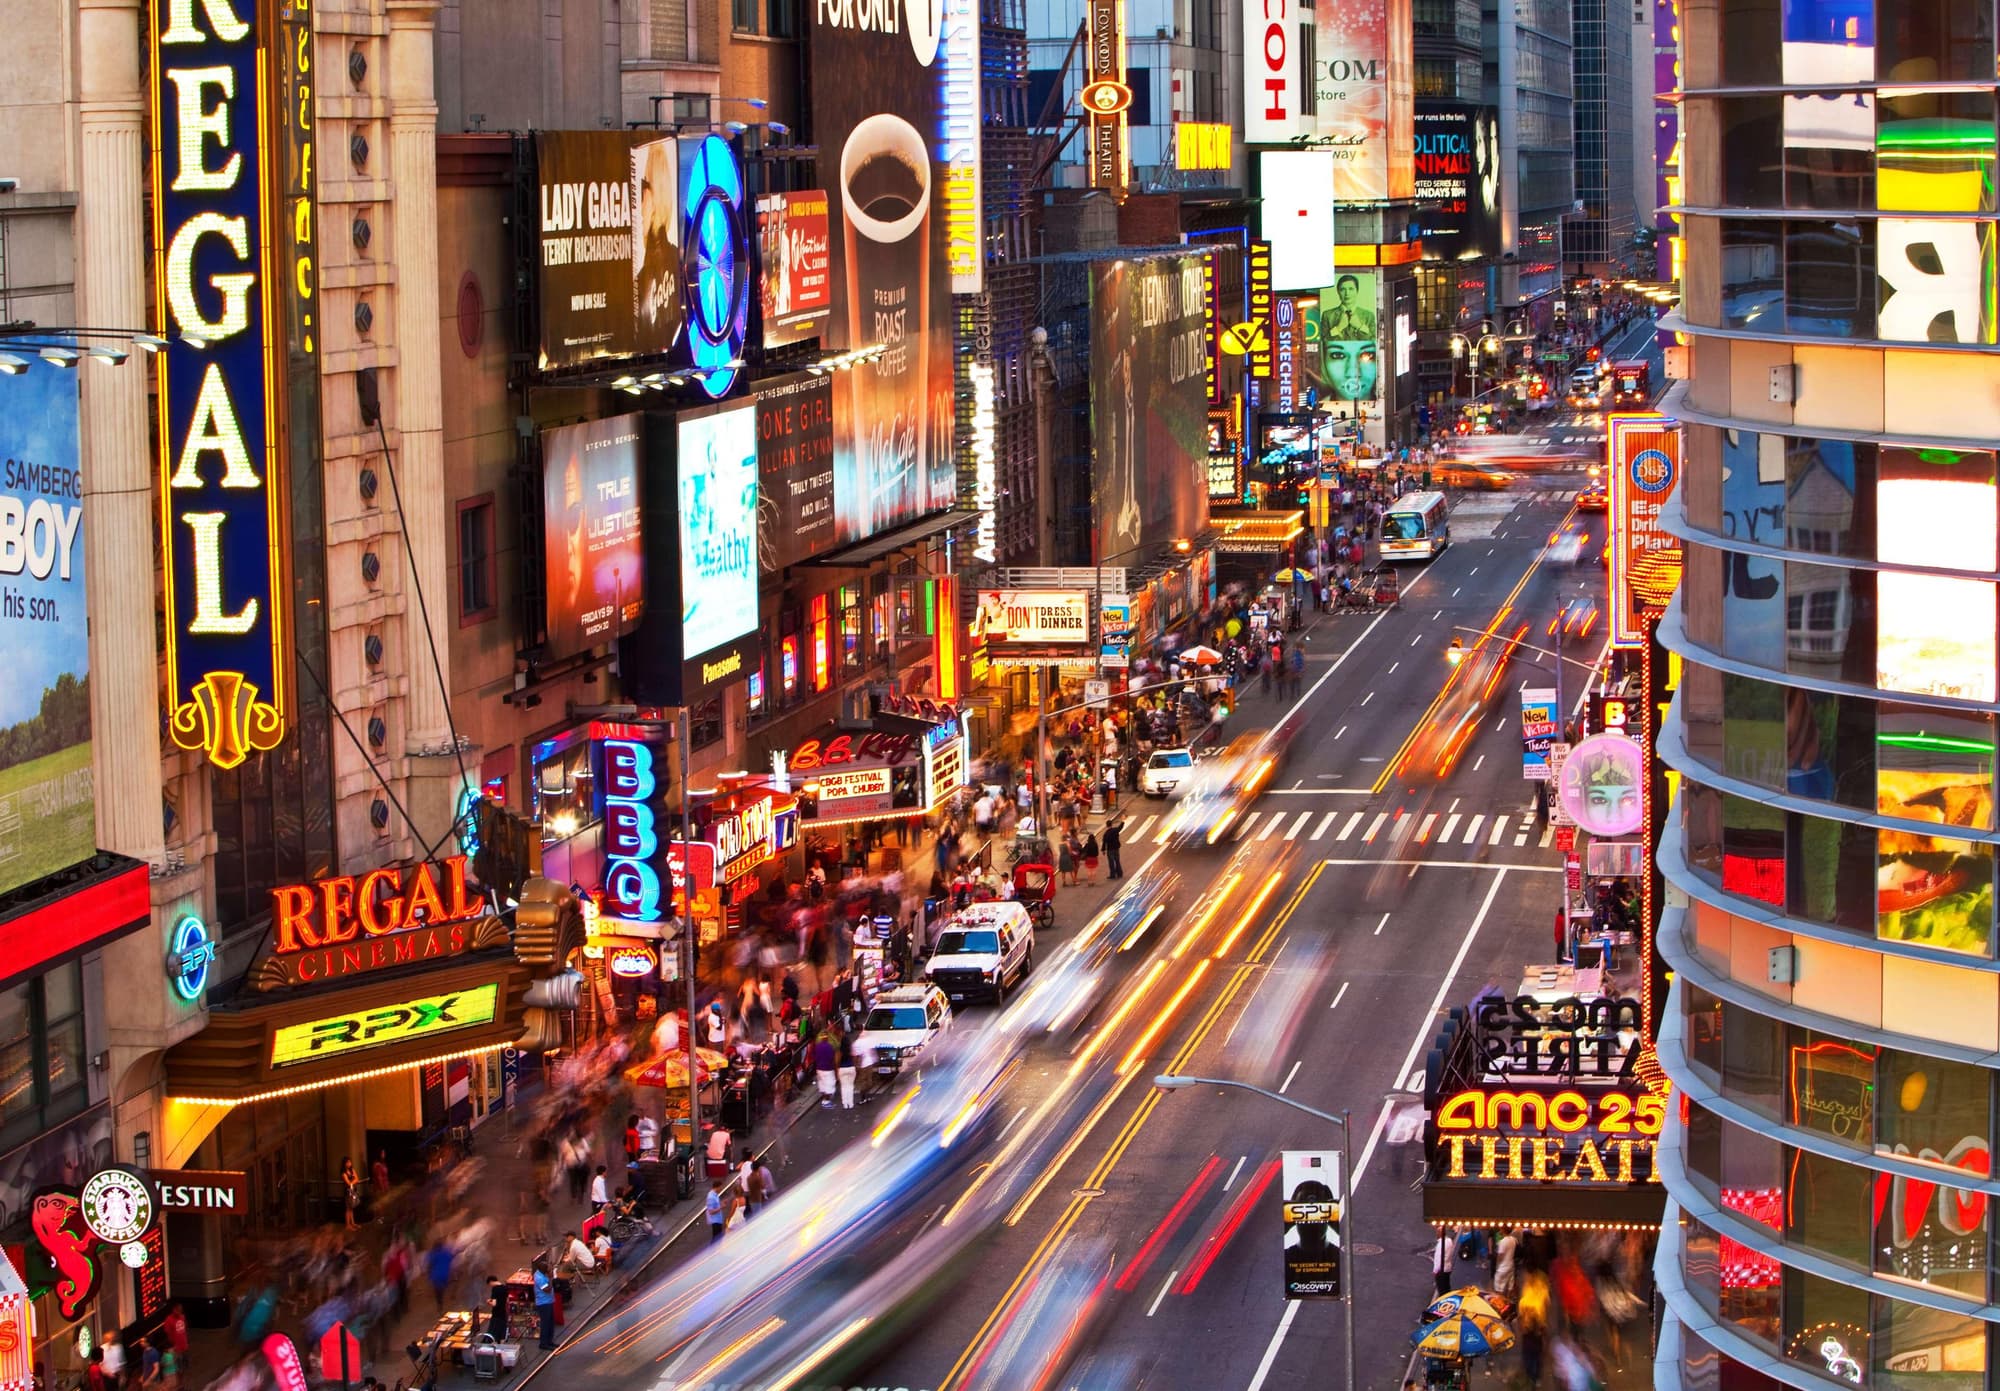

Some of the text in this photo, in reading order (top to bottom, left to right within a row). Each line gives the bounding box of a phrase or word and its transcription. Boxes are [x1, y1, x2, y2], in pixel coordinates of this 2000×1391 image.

[1098, 8, 1111, 75] FOXWOODS
[1101, 122, 1113, 179] THEATRE
[542, 181, 632, 232] LADY GAGA
[542, 234, 632, 266] TERRY RICHARDSON
[571, 292, 606, 311] NOW ON SALE
[874, 287, 906, 306] PREMIUM
[1142, 272, 1181, 328] LEONARD
[874, 309, 906, 344] ROAST
[875, 346, 907, 377] COFFEE
[1170, 334, 1187, 385] OLD
[1279, 331, 1293, 415] SKECHERS
[765, 388, 776, 399] THIS
[776, 381, 799, 397] SUMMER'S
[799, 378, 818, 391] HOTTEST
[800, 400, 832, 431] GIRL
[5, 458, 82, 499] SAMBERG
[597, 475, 631, 504] TRUE
[809, 471, 832, 488] TWISTED
[588, 507, 641, 539] JUSTICE
[801, 503, 813, 519] AND
[1631, 500, 1664, 515] Ea
[0, 496, 82, 580] BOY
[1631, 518, 1660, 531] Dri
[3, 586, 60, 622] his son.
[581, 608, 605, 626] FRIDAYS
[1007, 606, 1072, 629] DON'T DRESS
[1103, 612, 1122, 623] New
[586, 624, 601, 637] MARCH
[1041, 617, 1083, 629] DINNER
[703, 649, 741, 686] Panasonic
[1523, 723, 1556, 738] Victory
[1524, 710, 1548, 723] New
[856, 732, 911, 766] King
[820, 772, 883, 787] CBGB FESTIVAL
[827, 783, 885, 797] POPA CHUBBY
[604, 742, 661, 922] BBQ
[717, 815, 742, 866] COLD
[726, 847, 765, 878] CREAMERY
[272, 854, 484, 954] REGAL
[182, 941, 216, 975] RPX
[298, 926, 465, 981] CINEMAS
[310, 996, 460, 1051] RPX
[1598, 1093, 1665, 1135] 25
[85, 1173, 147, 1206] STARBUCKS
[1291, 1204, 1332, 1220] SPY
[92, 1218, 142, 1240] COFFEE
[1290, 1282, 1333, 1291] Discovery
